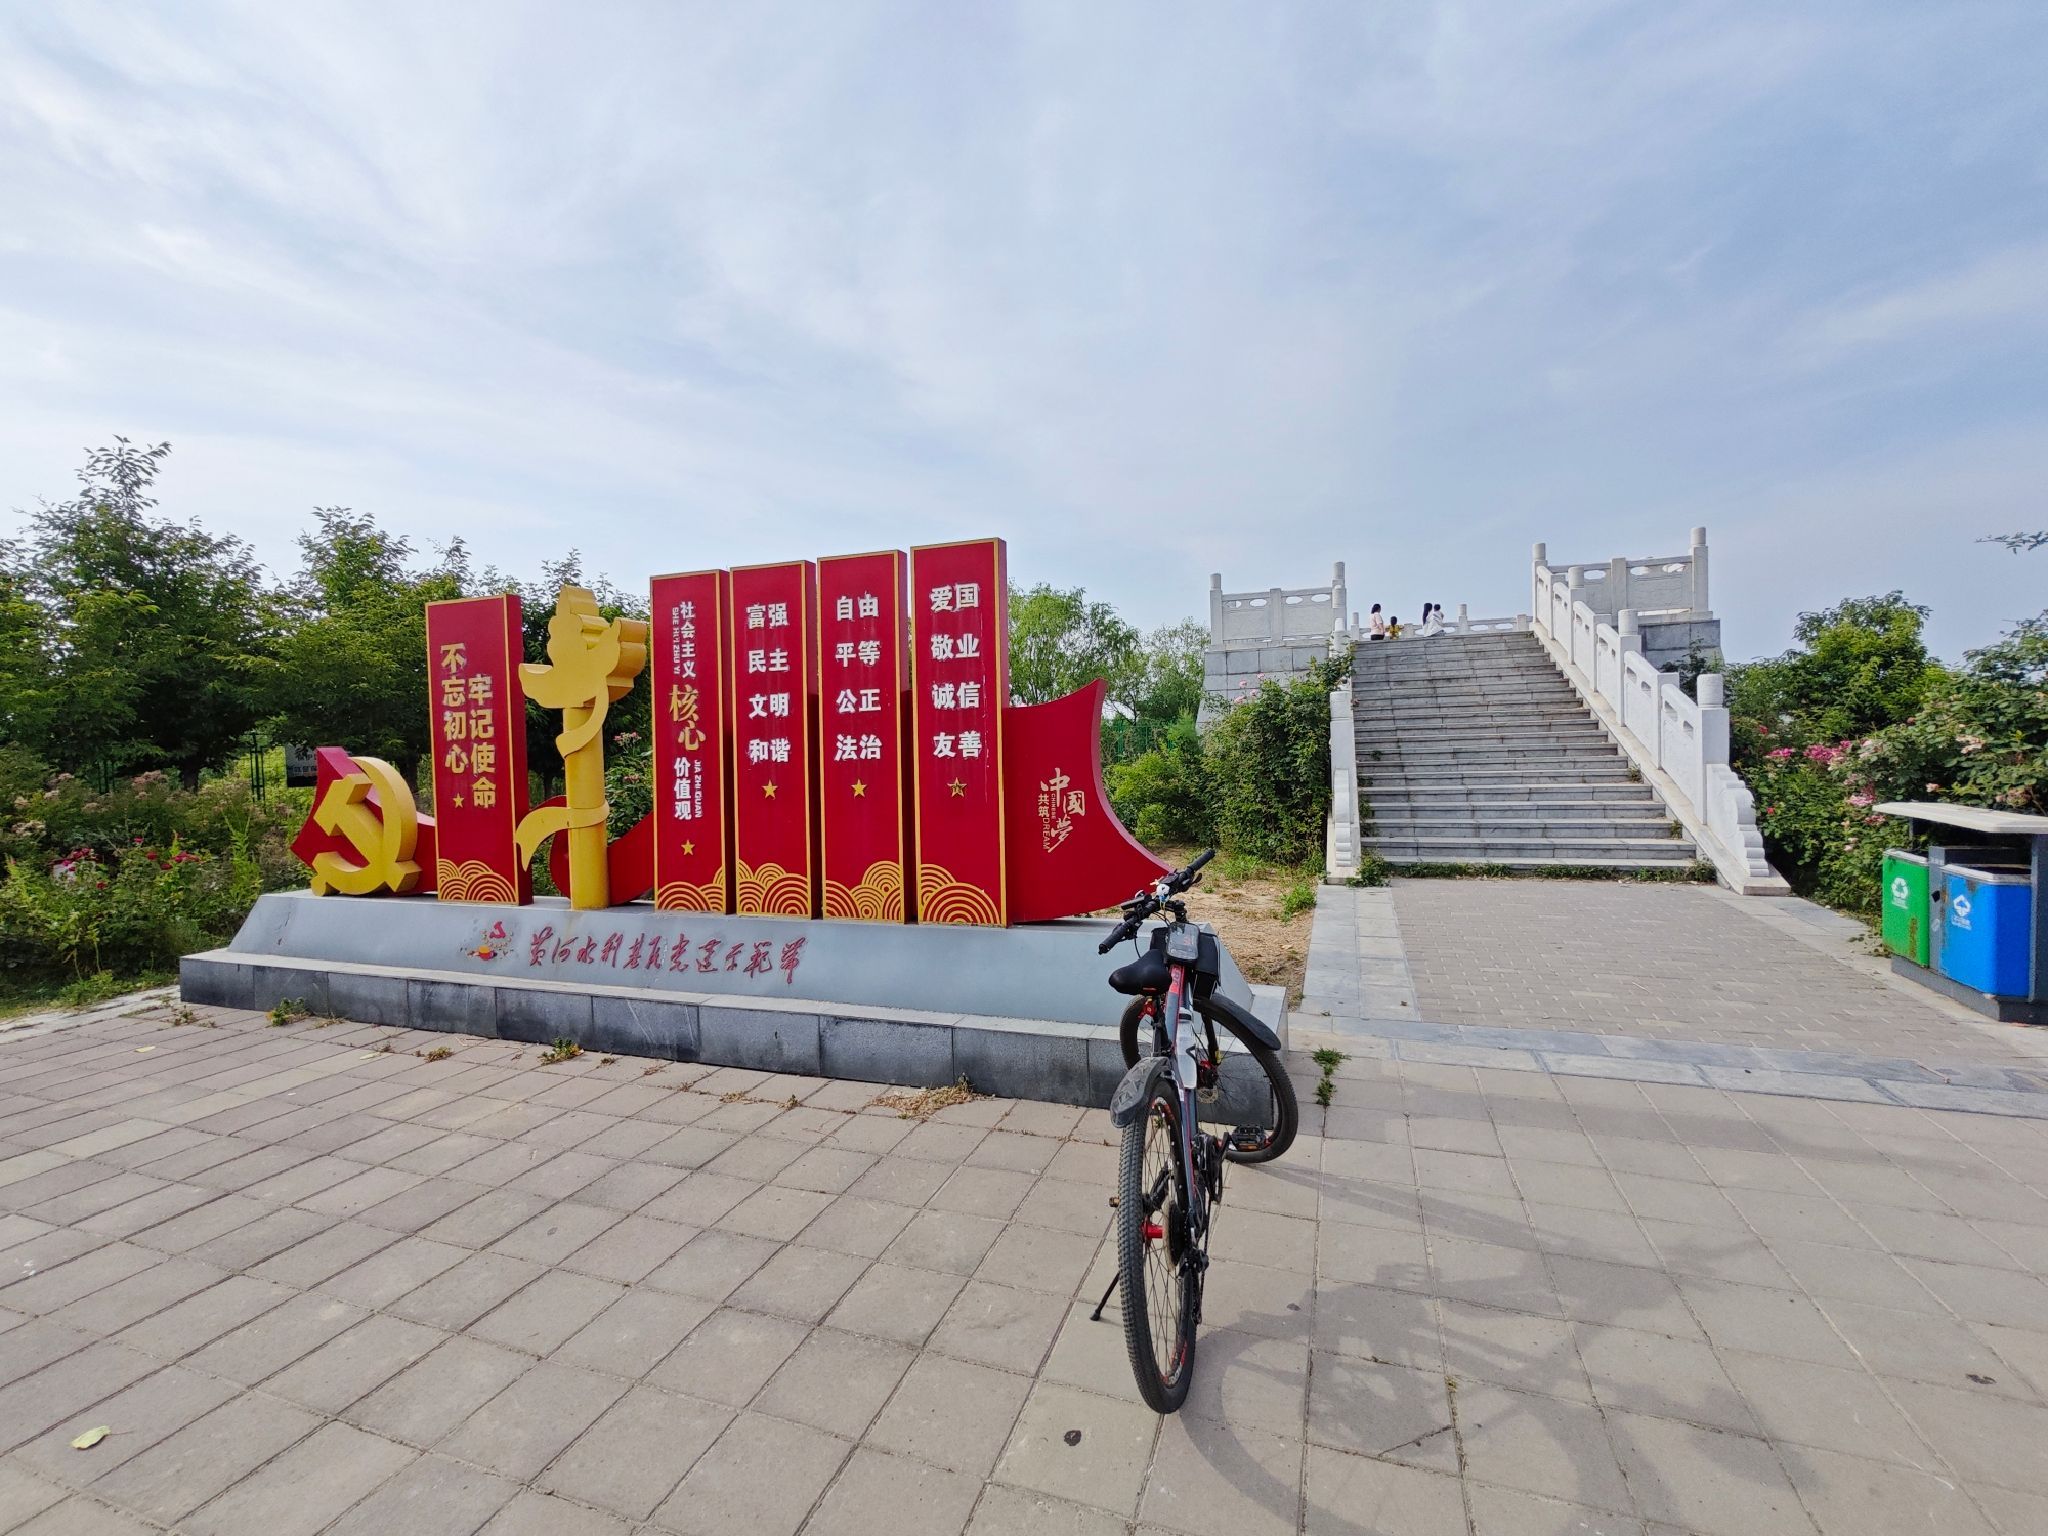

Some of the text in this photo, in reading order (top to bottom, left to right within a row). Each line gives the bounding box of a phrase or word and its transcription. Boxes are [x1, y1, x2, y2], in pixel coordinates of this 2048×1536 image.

[836, 592, 880, 622] 自由
[930, 583, 980, 612] 爱国
[746, 601, 790, 630] 富强
[680, 601, 696, 679] 社会主义
[835, 640, 881, 668] 平等
[930, 633, 980, 660] 敬业
[748, 648, 789, 674] 民主
[440, 643, 469, 774] 不忘初心
[748, 692, 790, 720] 文明
[836, 688, 882, 714] 公正
[931, 681, 981, 710] 诚信
[669, 684, 707, 751] 核心
[468, 673, 497, 809] 牢记使命
[748, 737, 791, 765] 和谐
[834, 733, 882, 762] 法治
[933, 730, 983, 758] 友善
[674, 756, 692, 820] 价值观
[1042, 817, 1051, 850] DREAM
